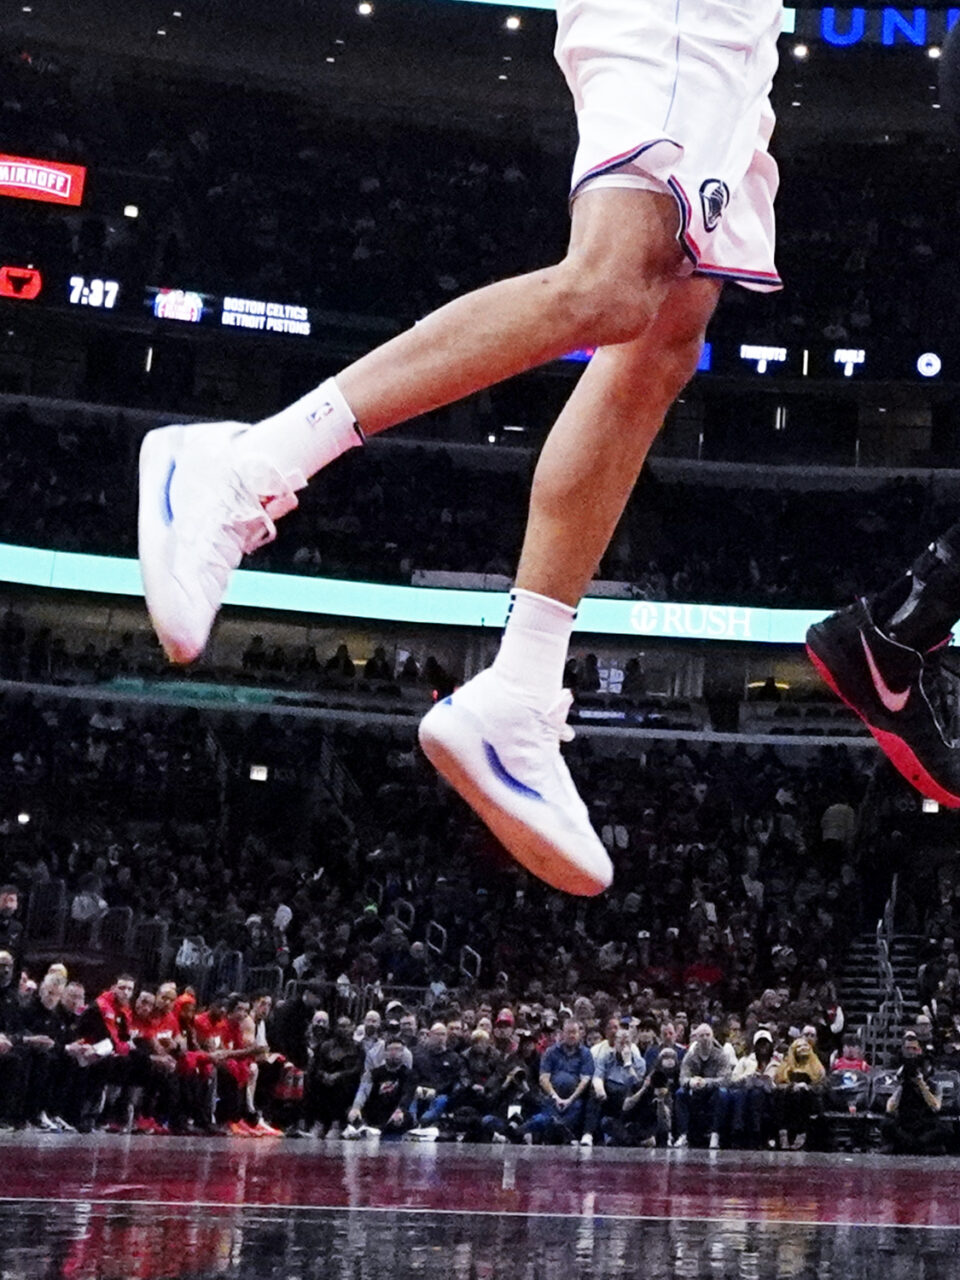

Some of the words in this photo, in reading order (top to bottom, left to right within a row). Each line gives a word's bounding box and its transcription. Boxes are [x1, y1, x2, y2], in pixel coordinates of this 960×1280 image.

[69, 276, 119, 308] 7:37
[266, 303, 308, 321] CELTICS
[266, 317, 311, 335] PISTONS
[662, 604, 751, 636] RUSH
